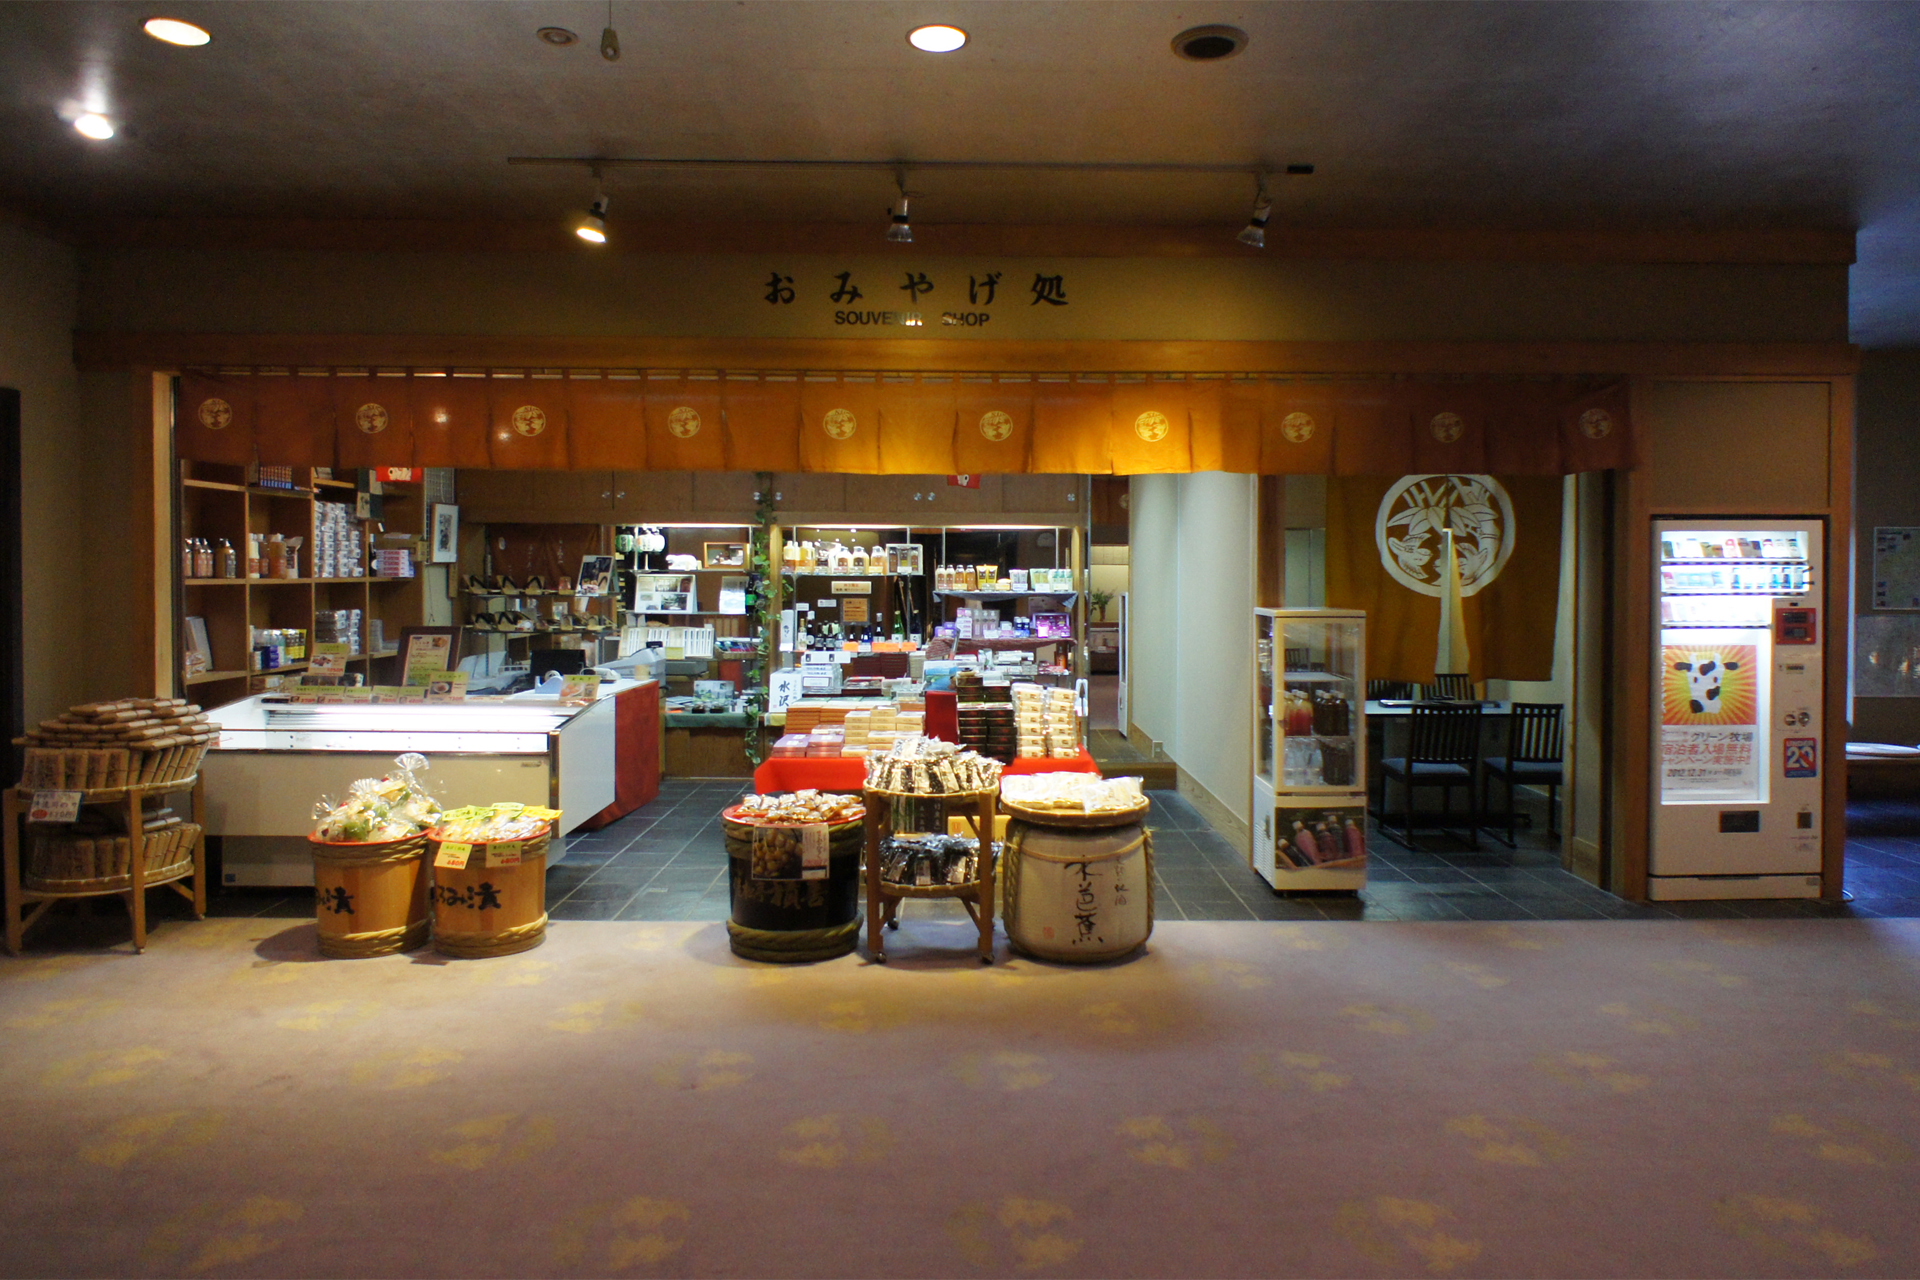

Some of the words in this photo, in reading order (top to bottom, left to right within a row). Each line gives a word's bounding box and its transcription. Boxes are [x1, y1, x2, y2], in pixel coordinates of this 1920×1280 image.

[764, 271, 1069, 306] おみやげ処
[942, 311, 990, 326] SHOP
[1786, 747, 1815, 768] 20
